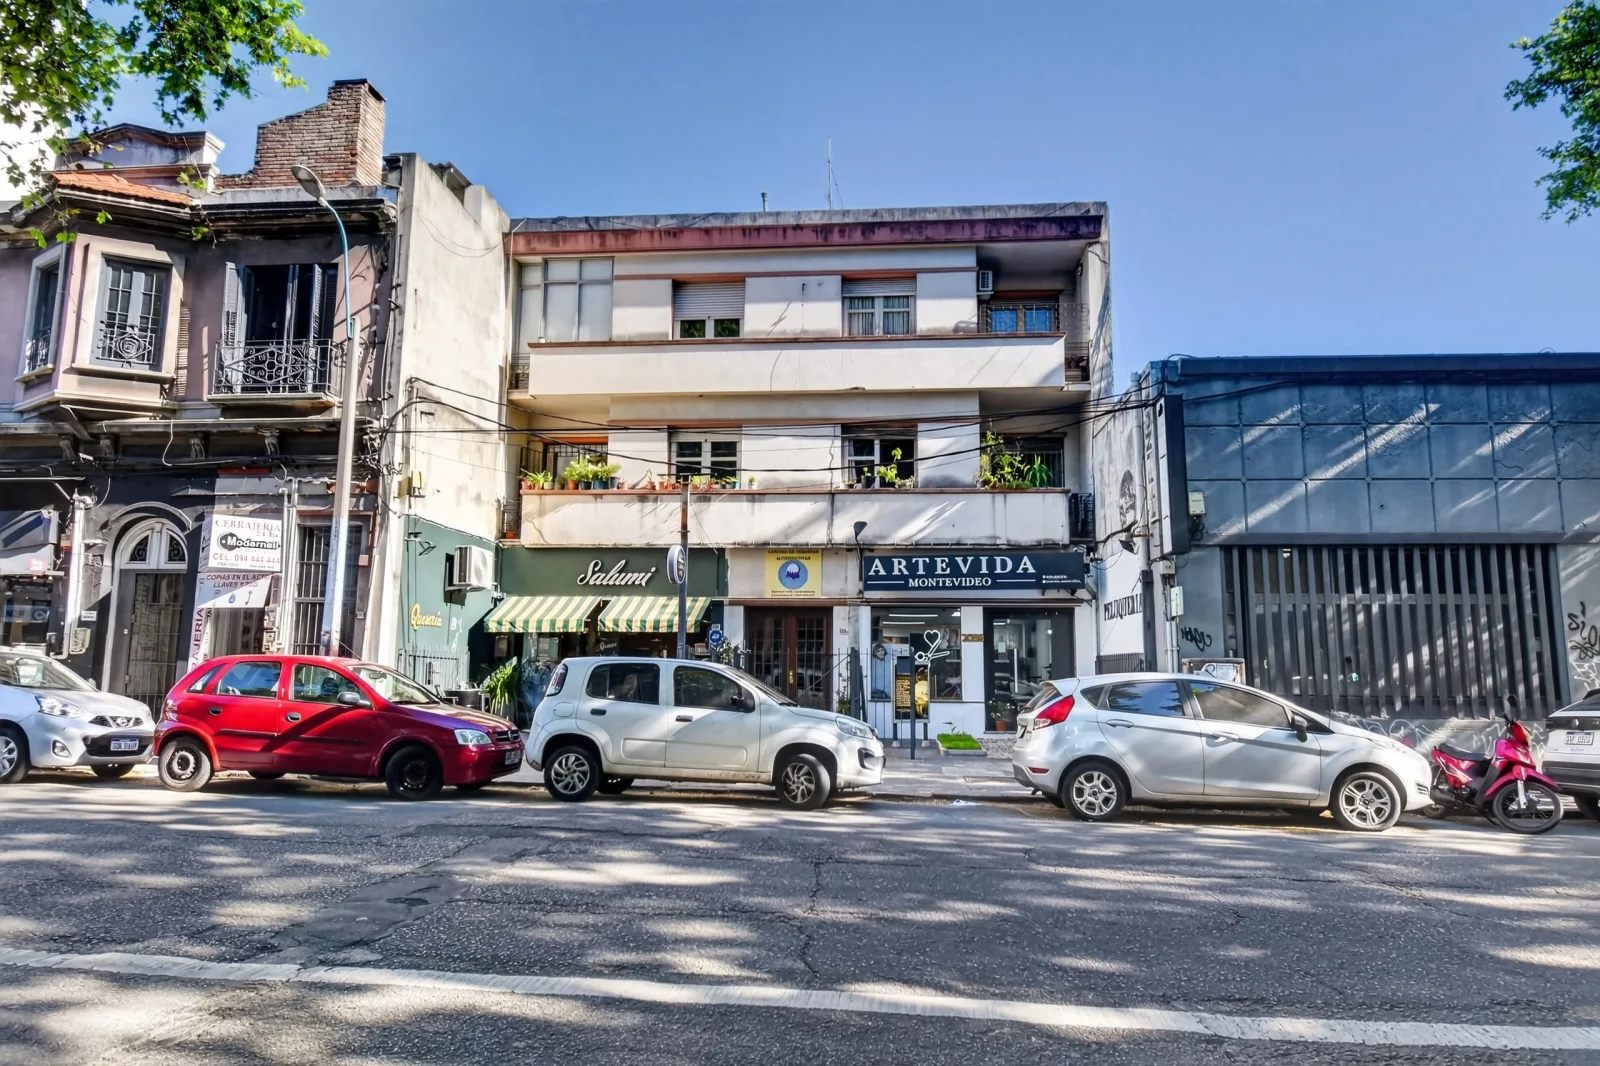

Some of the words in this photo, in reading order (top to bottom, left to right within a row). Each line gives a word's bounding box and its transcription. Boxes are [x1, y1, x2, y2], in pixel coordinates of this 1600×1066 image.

[576, 559, 657, 587] Salumi
[868, 555, 1036, 575] ARTEVIDA
[908, 577, 992, 587] MONTEVIDEO
